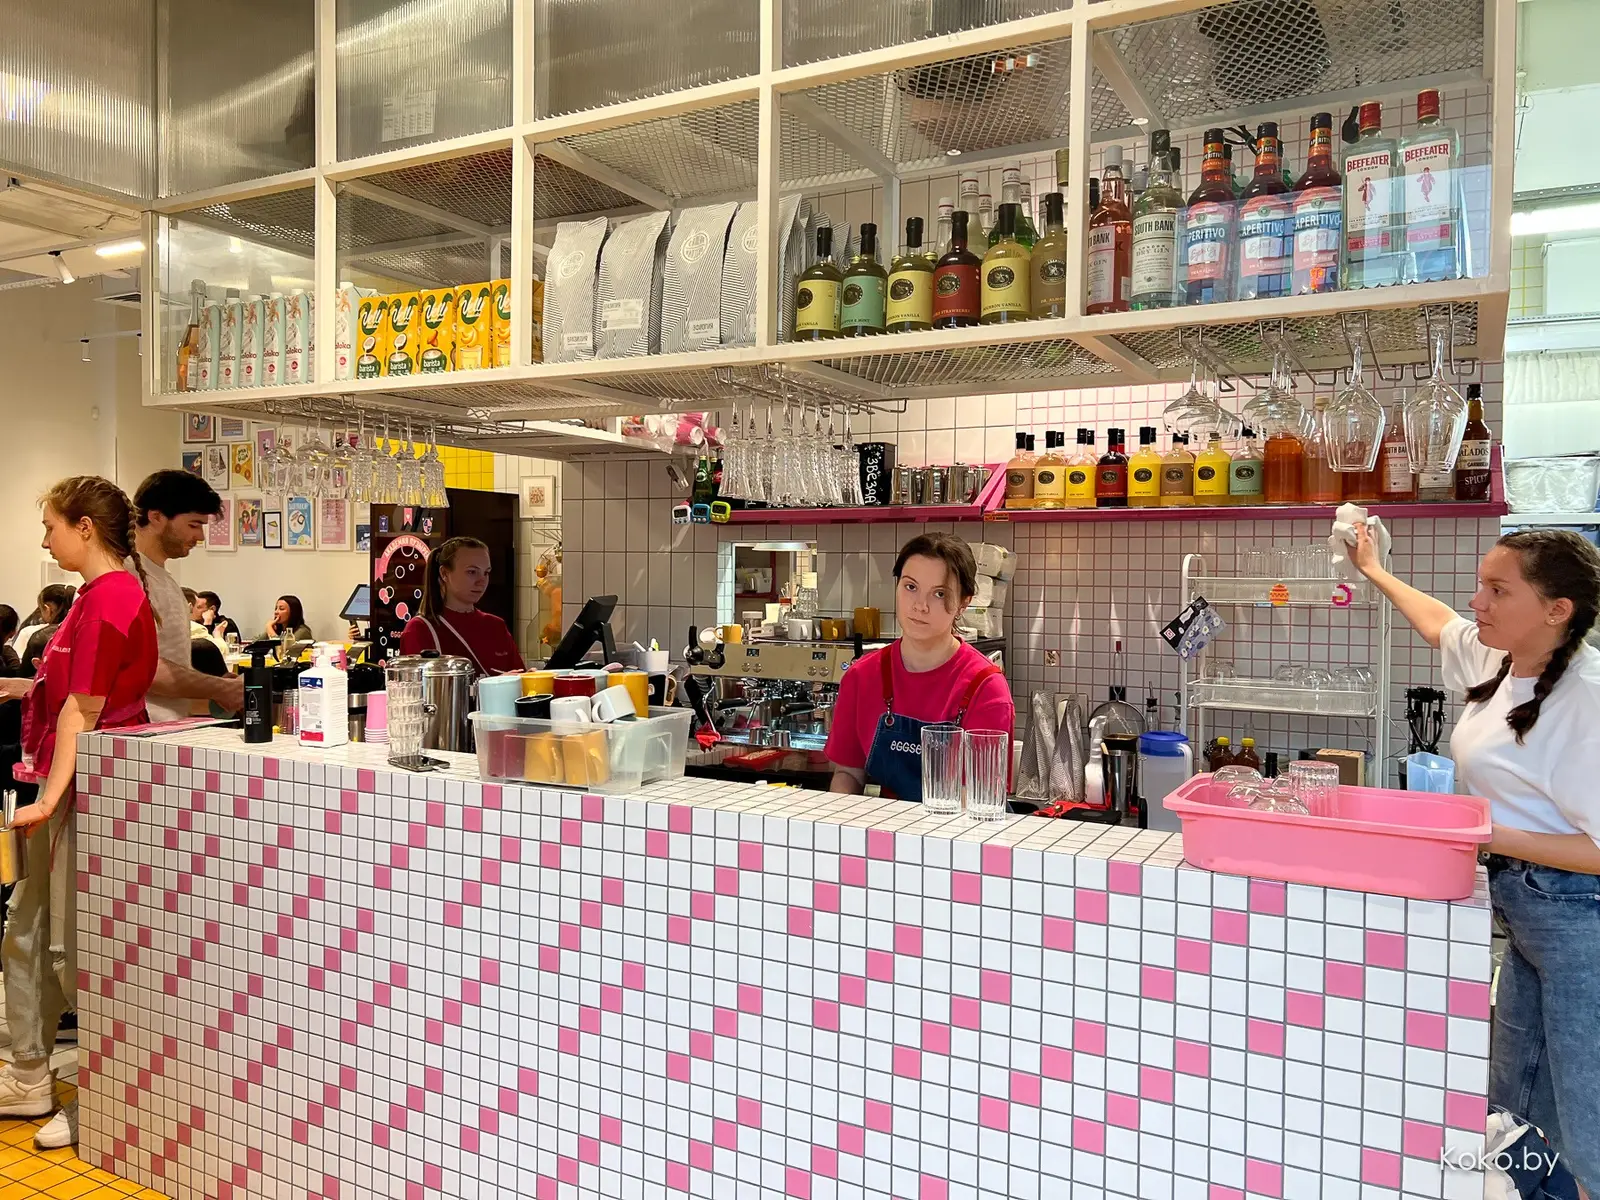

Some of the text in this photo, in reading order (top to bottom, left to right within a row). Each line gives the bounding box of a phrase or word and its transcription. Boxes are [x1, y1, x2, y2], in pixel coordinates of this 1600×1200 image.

[1404, 143, 1449, 163] BEEFEATER
[1346, 154, 1390, 173] BEEFEATER
[1134, 220, 1174, 236] SOUTH BANK
[1242, 221, 1285, 236] APERITIVO
[1295, 213, 1340, 229] APERITIVO
[359, 364, 375, 373] barista
[390, 362, 406, 370] barista
[423, 359, 440, 367] barista
